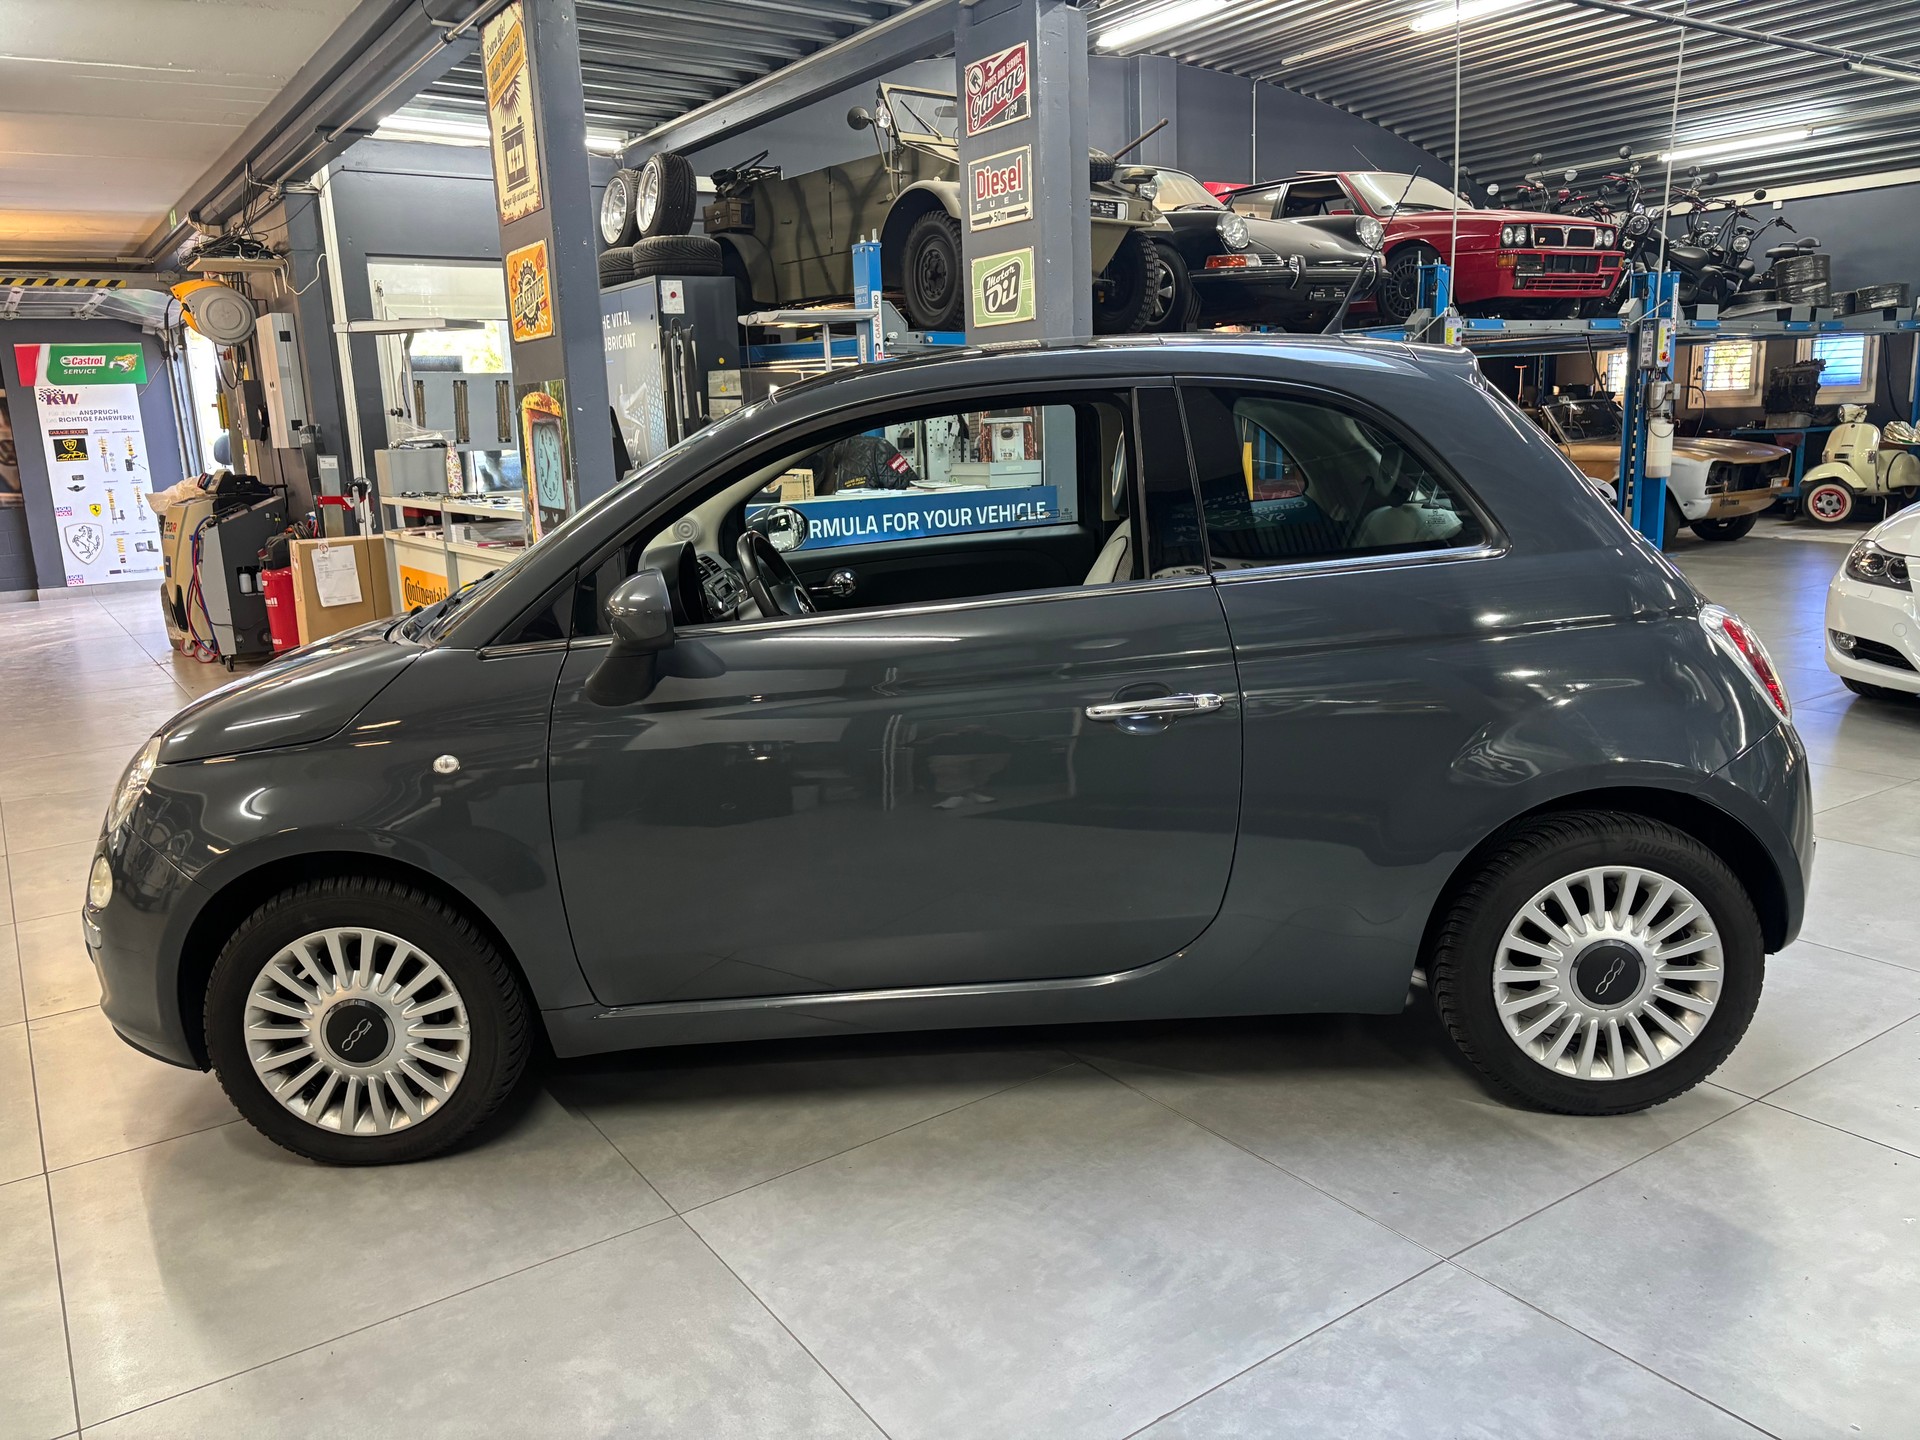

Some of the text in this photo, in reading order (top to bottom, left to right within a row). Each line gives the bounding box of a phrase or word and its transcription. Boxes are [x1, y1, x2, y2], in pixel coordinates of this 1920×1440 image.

[501, 33, 520, 72] Batteries
[984, 73, 997, 91] PARTS
[1006, 51, 1022, 73] SERVICE
[970, 64, 1025, 130] Garage
[975, 155, 1023, 201] Diesel
[976, 193, 1024, 211] FUEL
[993, 210, 1008, 223] 50m
[985, 265, 1016, 290] Motor
[514, 275, 545, 319] CAR SERVICE
[985, 275, 1017, 312] Oil
[611, 310, 632, 329] VITAL
[71, 356, 104, 366] Castrol
[79, 408, 119, 416] ANSPRUCH
[94, 414, 135, 422] FAHRWERK!
[883, 510, 920, 534] FOR
[923, 506, 972, 530] YOUR
[975, 501, 1047, 525] VEHICLE
[404, 576, 443, 607] Continental
